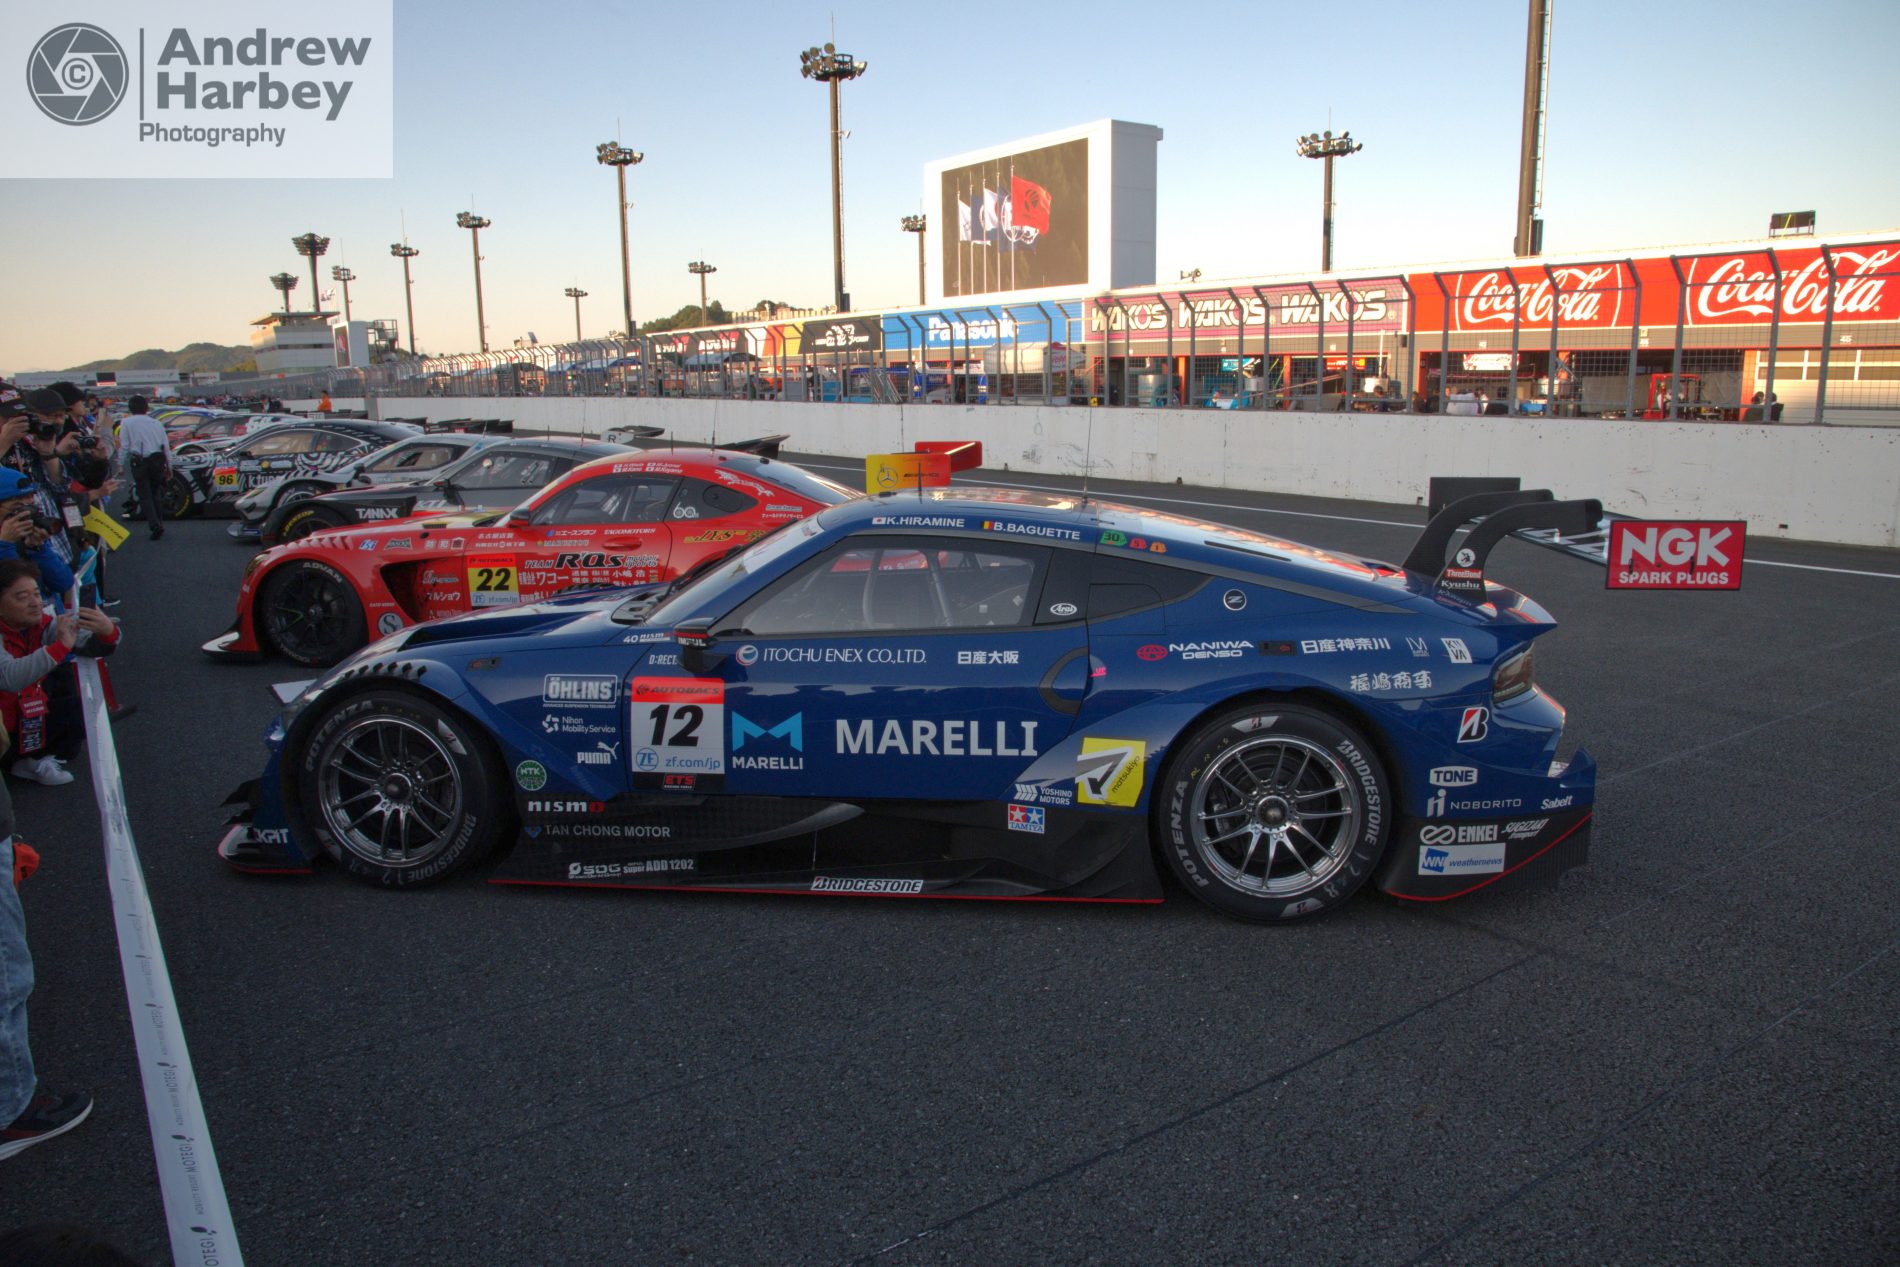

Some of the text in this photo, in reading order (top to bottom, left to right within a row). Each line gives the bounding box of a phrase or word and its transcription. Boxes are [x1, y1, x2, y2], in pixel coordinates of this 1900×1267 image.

[1696, 249, 1900, 319] Coca-Cola
[1463, 266, 1613, 325] Coca-Cola
[1178, 298, 1268, 328] WAKO'S
[1280, 289, 1387, 324] WAKO'S
[927, 314, 1019, 342] Panasonic
[219, 474, 233, 485] 96
[355, 507, 399, 519] TANAX
[886, 516, 966, 529] K.HIRAMINE
[993, 521, 1081, 541] B.BAGUETTE
[1103, 531, 1120, 542] 30
[1619, 526, 1734, 568] NGK
[302, 561, 343, 583] ADVAN
[1618, 572, 1729, 585] SPARK PLUGS
[476, 567, 511, 592] 22
[623, 634, 639, 643] 40
[1300, 637, 1392, 654] 日産神奈川
[1168, 640, 1254, 652] NANIWA
[763, 648, 927, 664] ITOCHU ENEX CO.,LTD.
[957, 650, 1019, 665] 日産大阪
[1182, 649, 1243, 660] DENSO
[549, 676, 612, 700] ÖHLINS
[650, 686, 720, 695] AUTOBACS
[562, 716, 583, 725] Nihon
[650, 704, 704, 747] 12
[562, 724, 616, 734] Mobility Service
[836, 719, 1038, 757] MARELLI
[577, 752, 611, 764] PUMA
[665, 757, 721, 770] zf.com/jp
[732, 756, 804, 770] MARELLI
[1434, 769, 1474, 783] TONE
[1040, 786, 1073, 798] YOSHINO
[1335, 740, 1382, 846] BRIDGESTONE
[527, 800, 605, 813] nismo
[1039, 795, 1071, 806] MOTORS
[1450, 799, 1522, 811] NOBORITO
[1540, 795, 1573, 810] Sabelt
[545, 825, 671, 838] TAN CHONG MOTOR
[1009, 822, 1044, 833] TAMIYA
[1171, 780, 1210, 887] POTENZA
[1458, 824, 1499, 843] ENKEI
[583, 859, 694, 874] SDG Super ADD 1202
[1449, 857, 1503, 868] weathernews
[814, 876, 922, 892] BRIDGESTONE
[180, 1143, 196, 1173] MOTEGI
[204, 1236, 220, 1267] OTEGI
